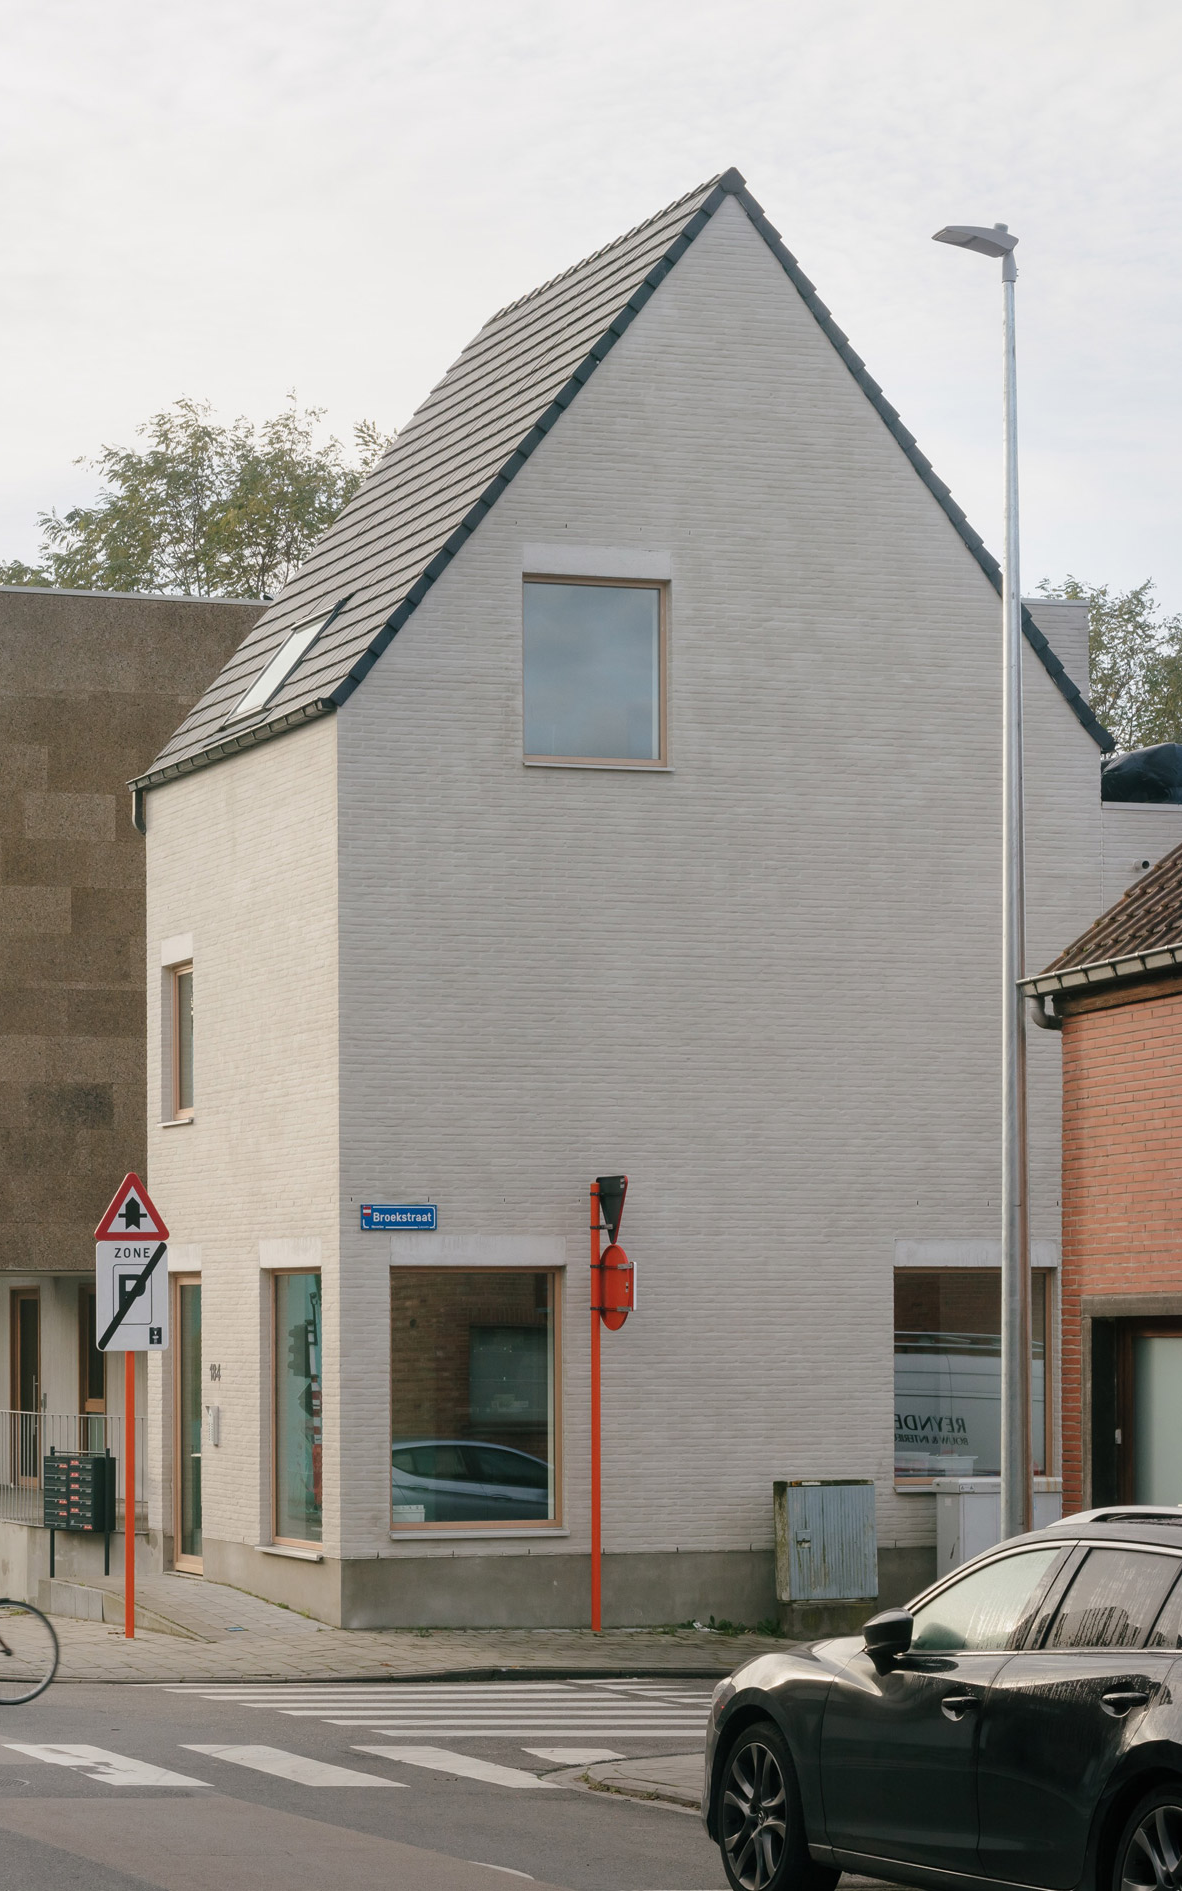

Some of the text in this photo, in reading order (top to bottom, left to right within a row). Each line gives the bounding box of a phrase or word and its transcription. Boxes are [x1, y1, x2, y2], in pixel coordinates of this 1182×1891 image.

[373, 1212, 432, 1222] Broekstraat
[114, 1247, 151, 1258] ZONE
[118, 1274, 146, 1317] P
[209, 1363, 222, 1382] 184
